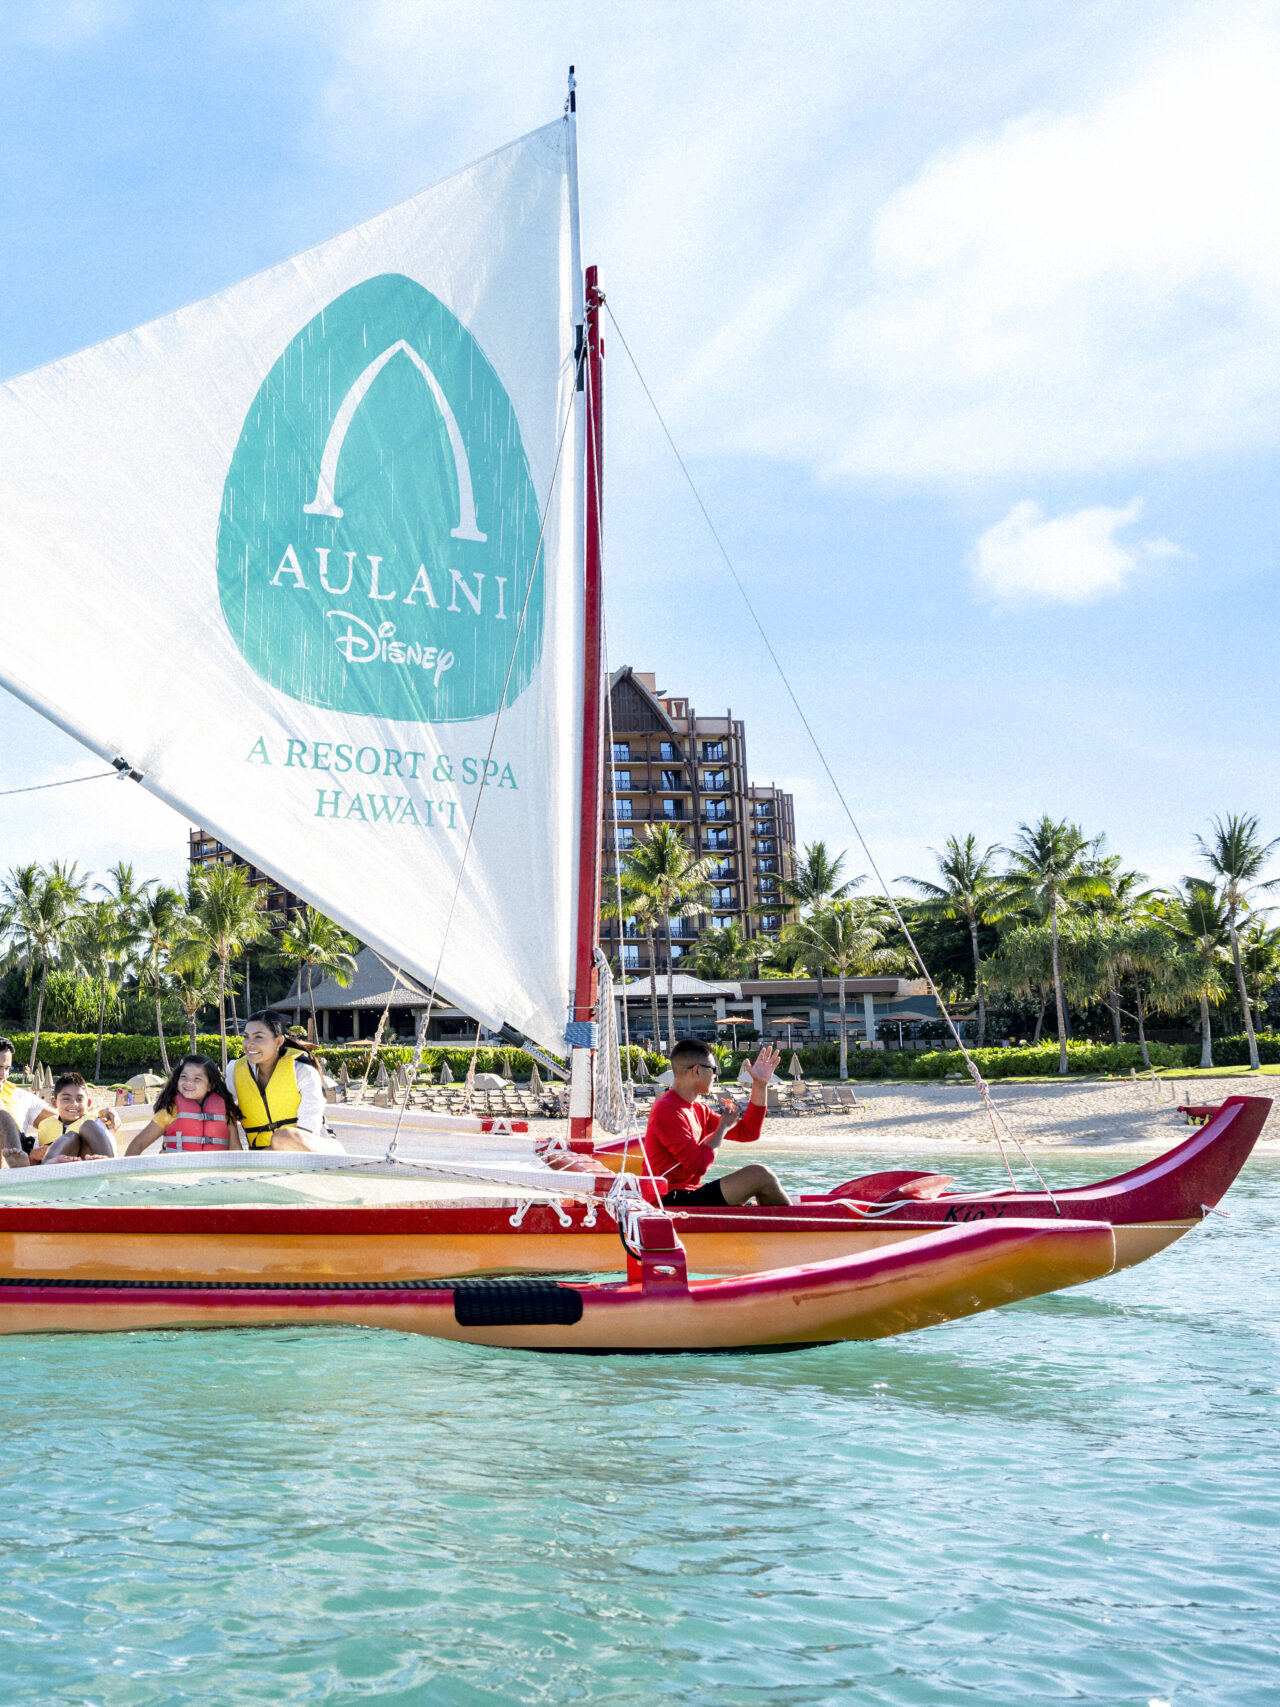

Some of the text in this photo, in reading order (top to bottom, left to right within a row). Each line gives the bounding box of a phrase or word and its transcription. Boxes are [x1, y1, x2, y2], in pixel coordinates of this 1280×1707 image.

[268, 543, 508, 621] AULANI
[326, 609, 455, 688] Disney
[244, 735, 520, 791] A RESORT & SPA
